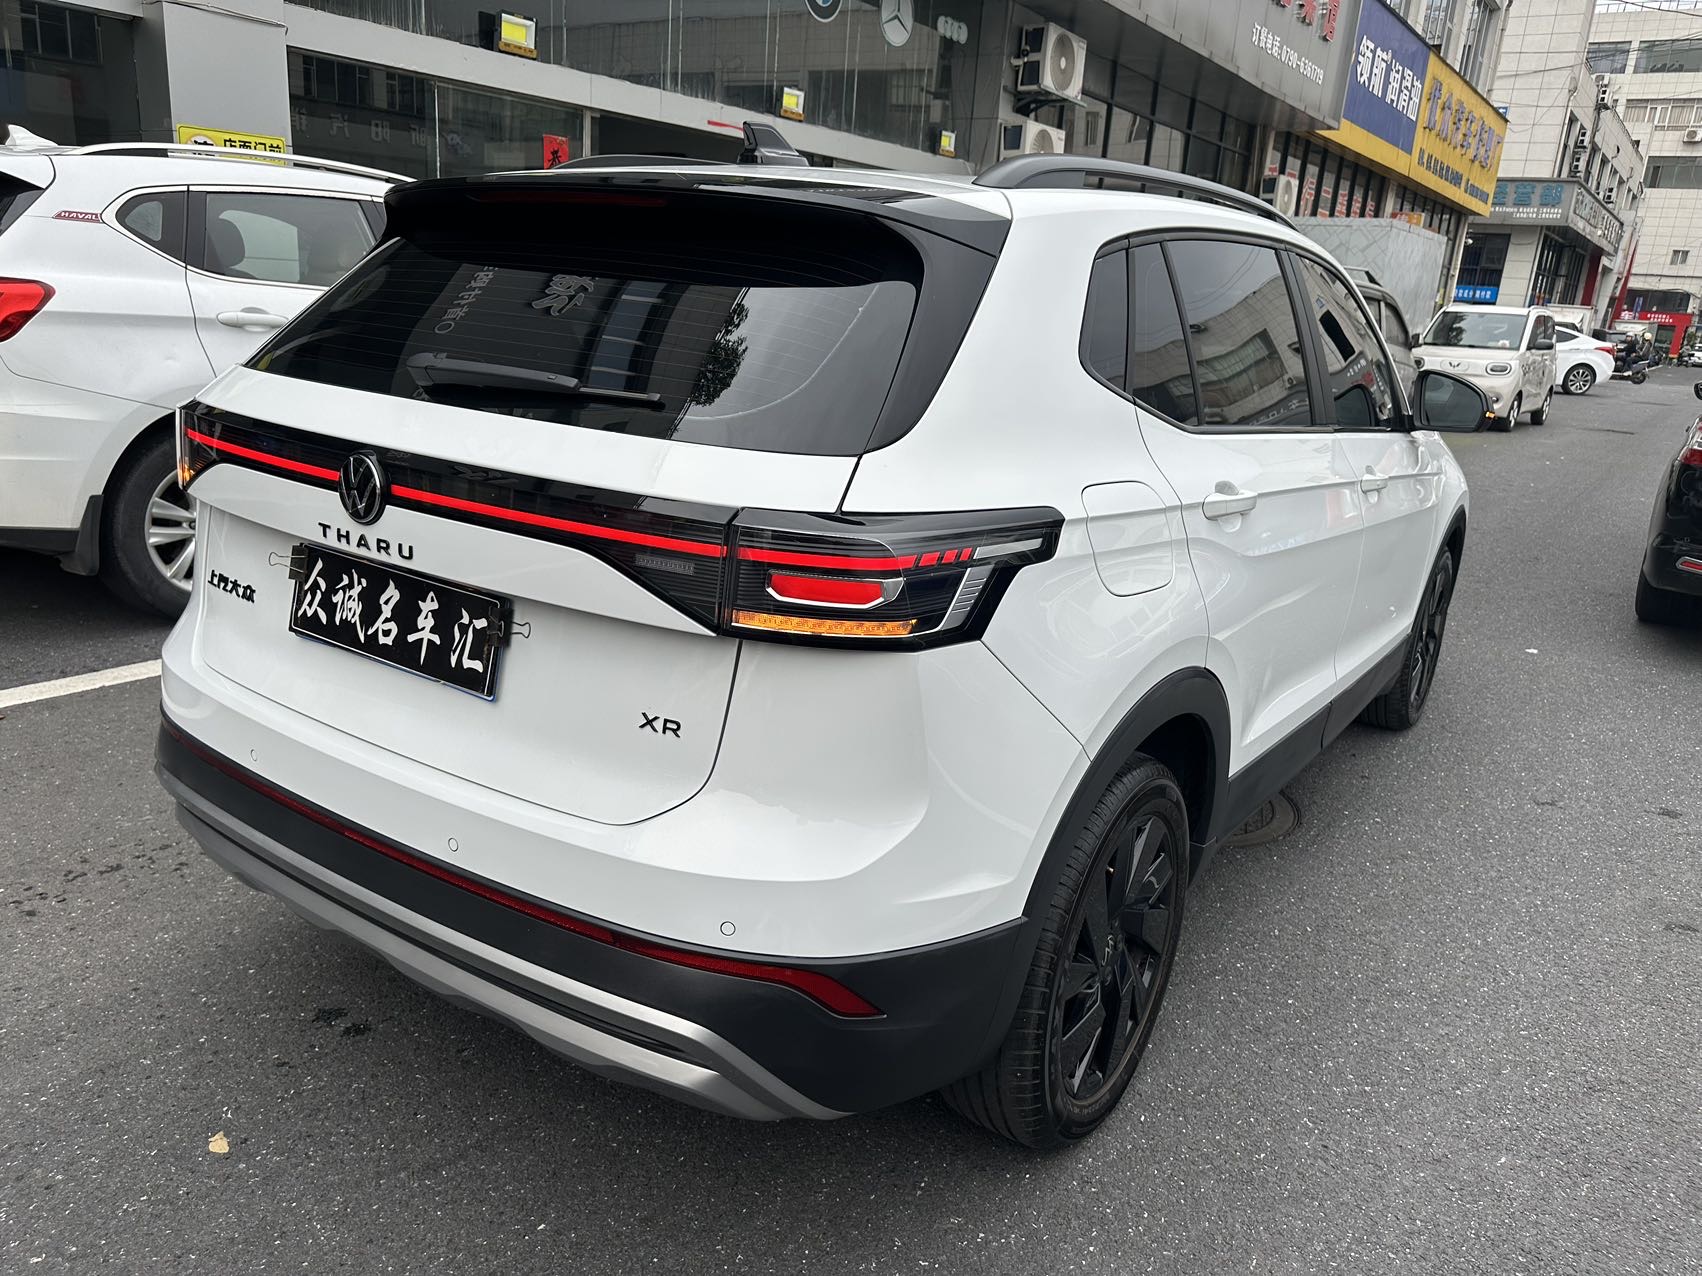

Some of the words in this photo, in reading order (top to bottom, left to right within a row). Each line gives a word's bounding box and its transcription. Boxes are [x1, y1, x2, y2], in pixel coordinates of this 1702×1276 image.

[60, 211, 98, 220] HAVAL
[318, 522, 415, 560] THARU
[208, 569, 256, 604] 上汽大众
[297, 557, 488, 673] 众诚名车汇
[638, 711, 681, 738] XR
